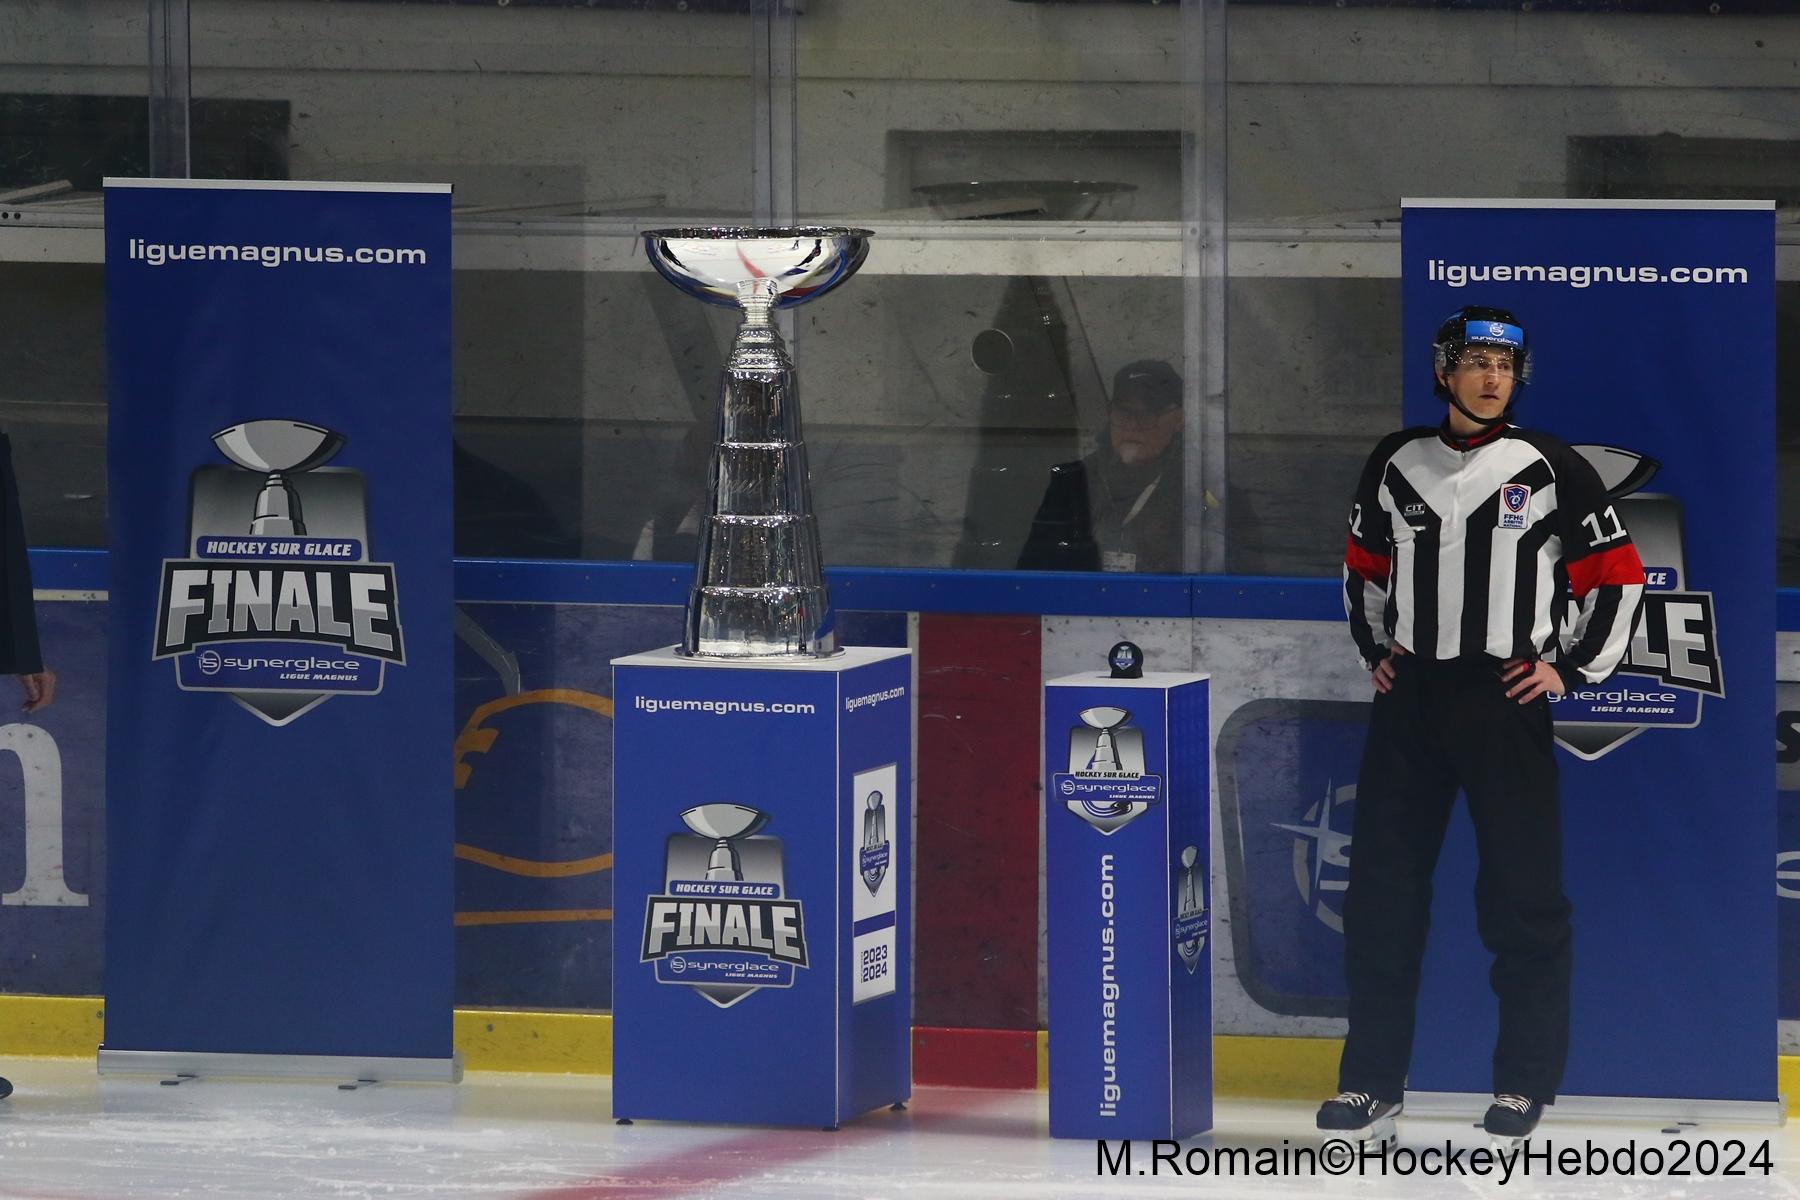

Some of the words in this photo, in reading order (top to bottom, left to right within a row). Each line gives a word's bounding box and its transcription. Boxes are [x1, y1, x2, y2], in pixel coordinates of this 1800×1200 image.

[129, 238, 427, 267] liguemagnus.com
[1428, 259, 1748, 288] liguemagnus.com
[1581, 505, 1627, 547] 11
[206, 541, 267, 555] HOCKEY
[269, 542, 302, 556] SUR
[304, 543, 352, 557] GLACE
[165, 569, 393, 651] FINALE
[224, 656, 360, 672] synerglace
[635, 696, 815, 715] liguemagnus.com
[846, 686, 904, 712] liguemagnus.com
[1076, 784, 1156, 792] synerglace
[676, 884, 717, 893] HOCKEY
[718, 884, 740, 894] SUR
[742, 886, 773, 896] GLACE
[648, 902, 800, 960] FINALE
[863, 944, 888, 965] 2023
[688, 961, 780, 972] synerglace
[862, 961, 887, 982] 2024
[1100, 854, 1120, 1116] liguemagnus.com
